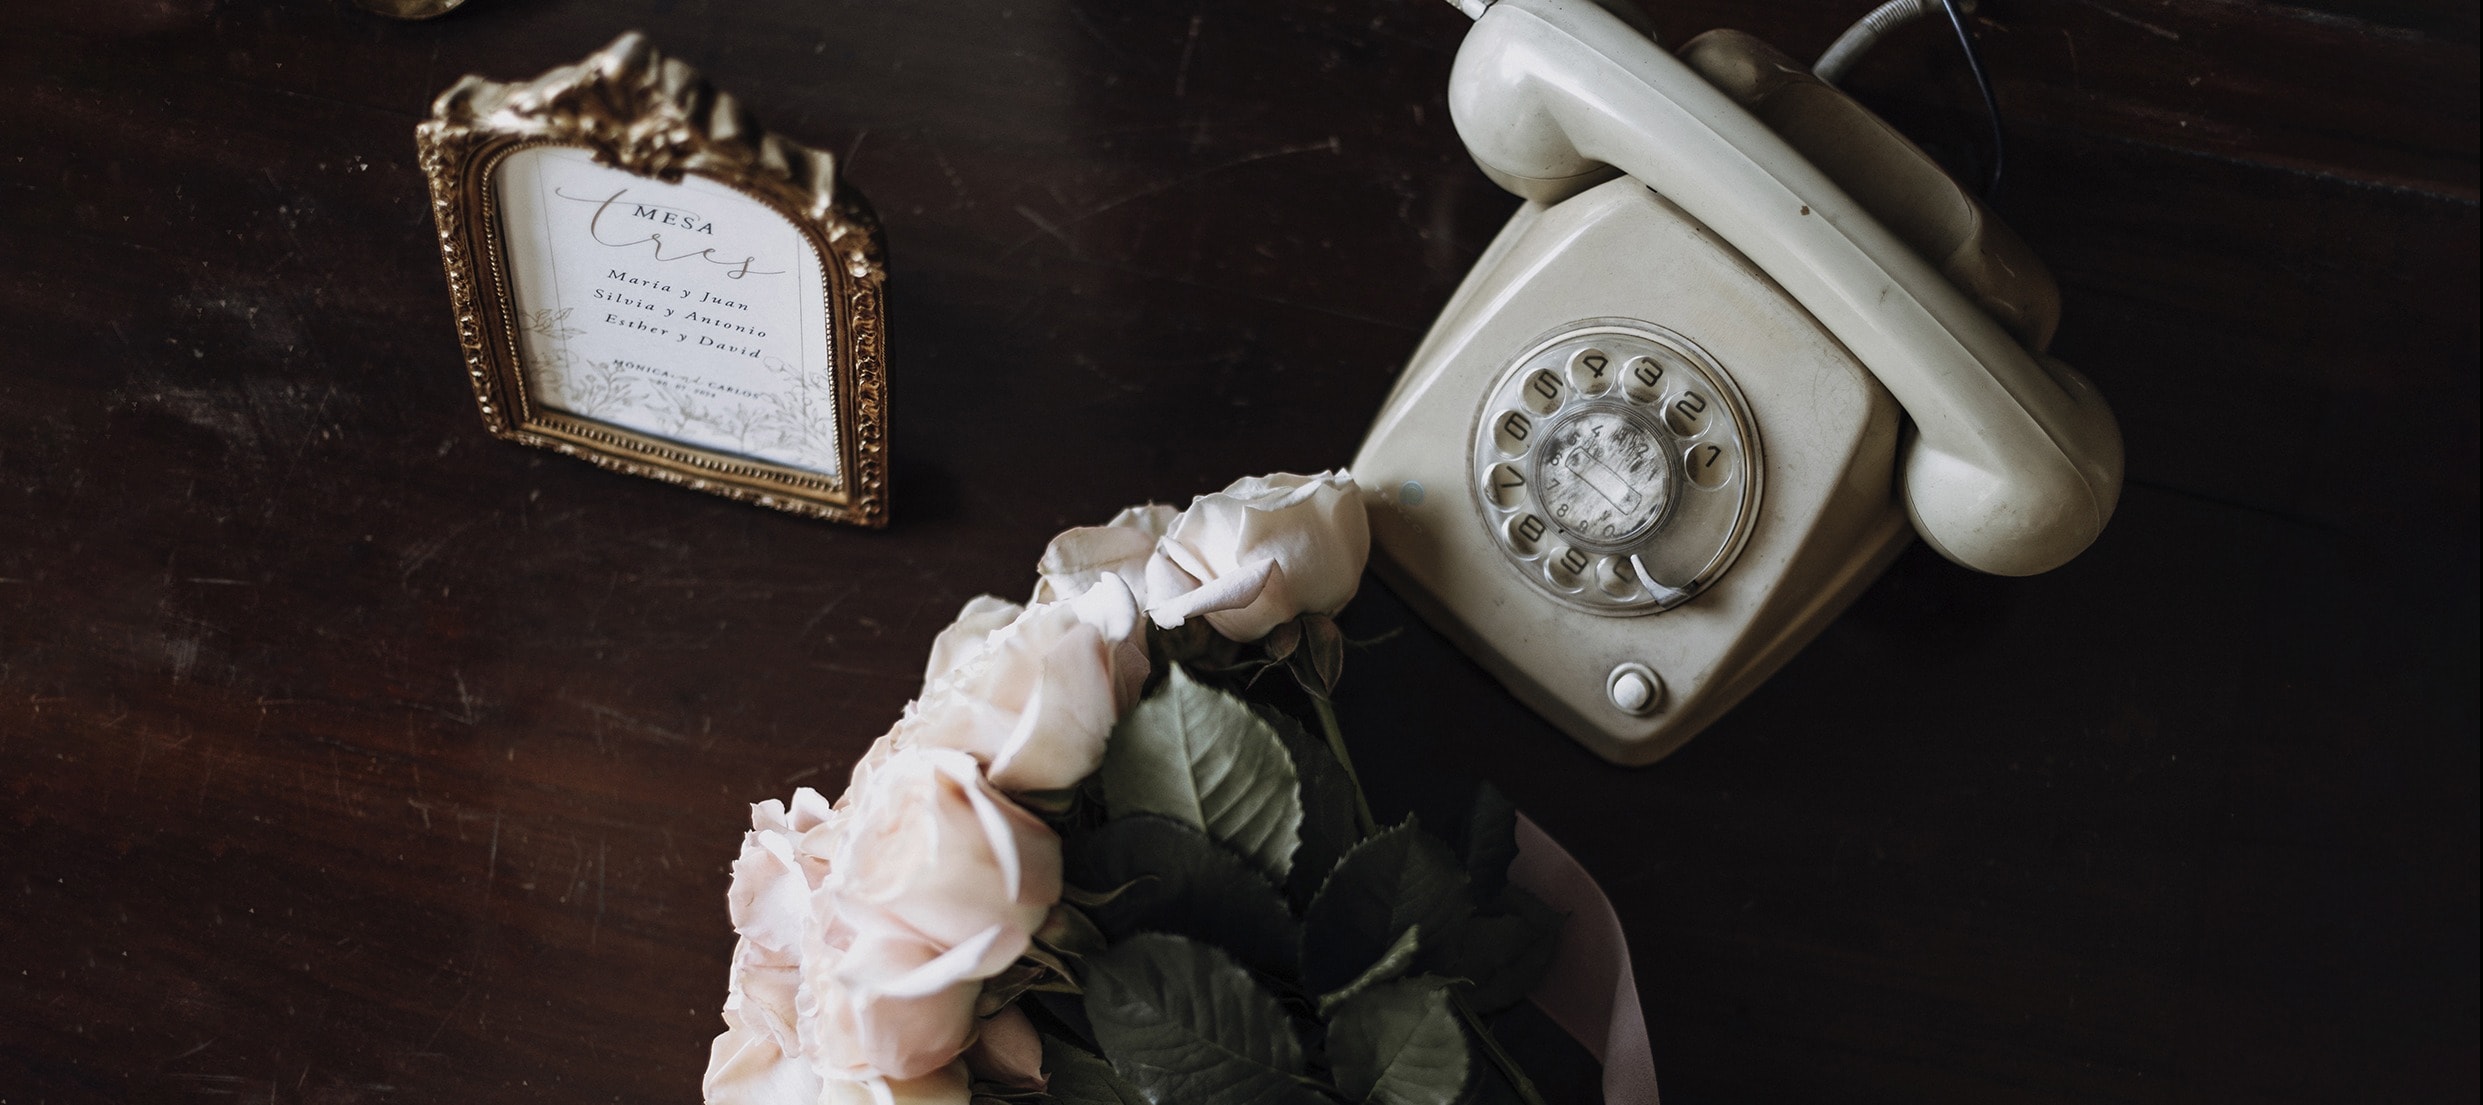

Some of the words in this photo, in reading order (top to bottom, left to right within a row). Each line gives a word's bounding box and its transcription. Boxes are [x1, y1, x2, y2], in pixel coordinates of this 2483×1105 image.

[555, 187, 786, 280] tres
[632, 204, 713, 235] MESA
[593, 288, 655, 311] Silvia
[664, 308, 675, 318] y
[685, 311, 768, 338] Antonio
[680, 289, 691, 299] y
[699, 291, 750, 311] Juan
[605, 313, 669, 336] Esther
[676, 333, 688, 342] y
[699, 335, 761, 359] David
[1582, 354, 1609, 379] 4
[1634, 356, 1664, 388] 3
[708, 382, 760, 399] CARLOS
[1533, 368, 1564, 400] 5
[1675, 390, 1706, 422] 2
[1503, 411, 1532, 442] 6
[1551, 452, 1562, 466] 6
[1705, 445, 1722, 468] 1
[1501, 465, 1526, 489] 7
[1546, 478, 1561, 491] 7
[1556, 503, 1569, 517] 8
[1518, 514, 1546, 543] 8
[1560, 548, 1588, 576] 9
